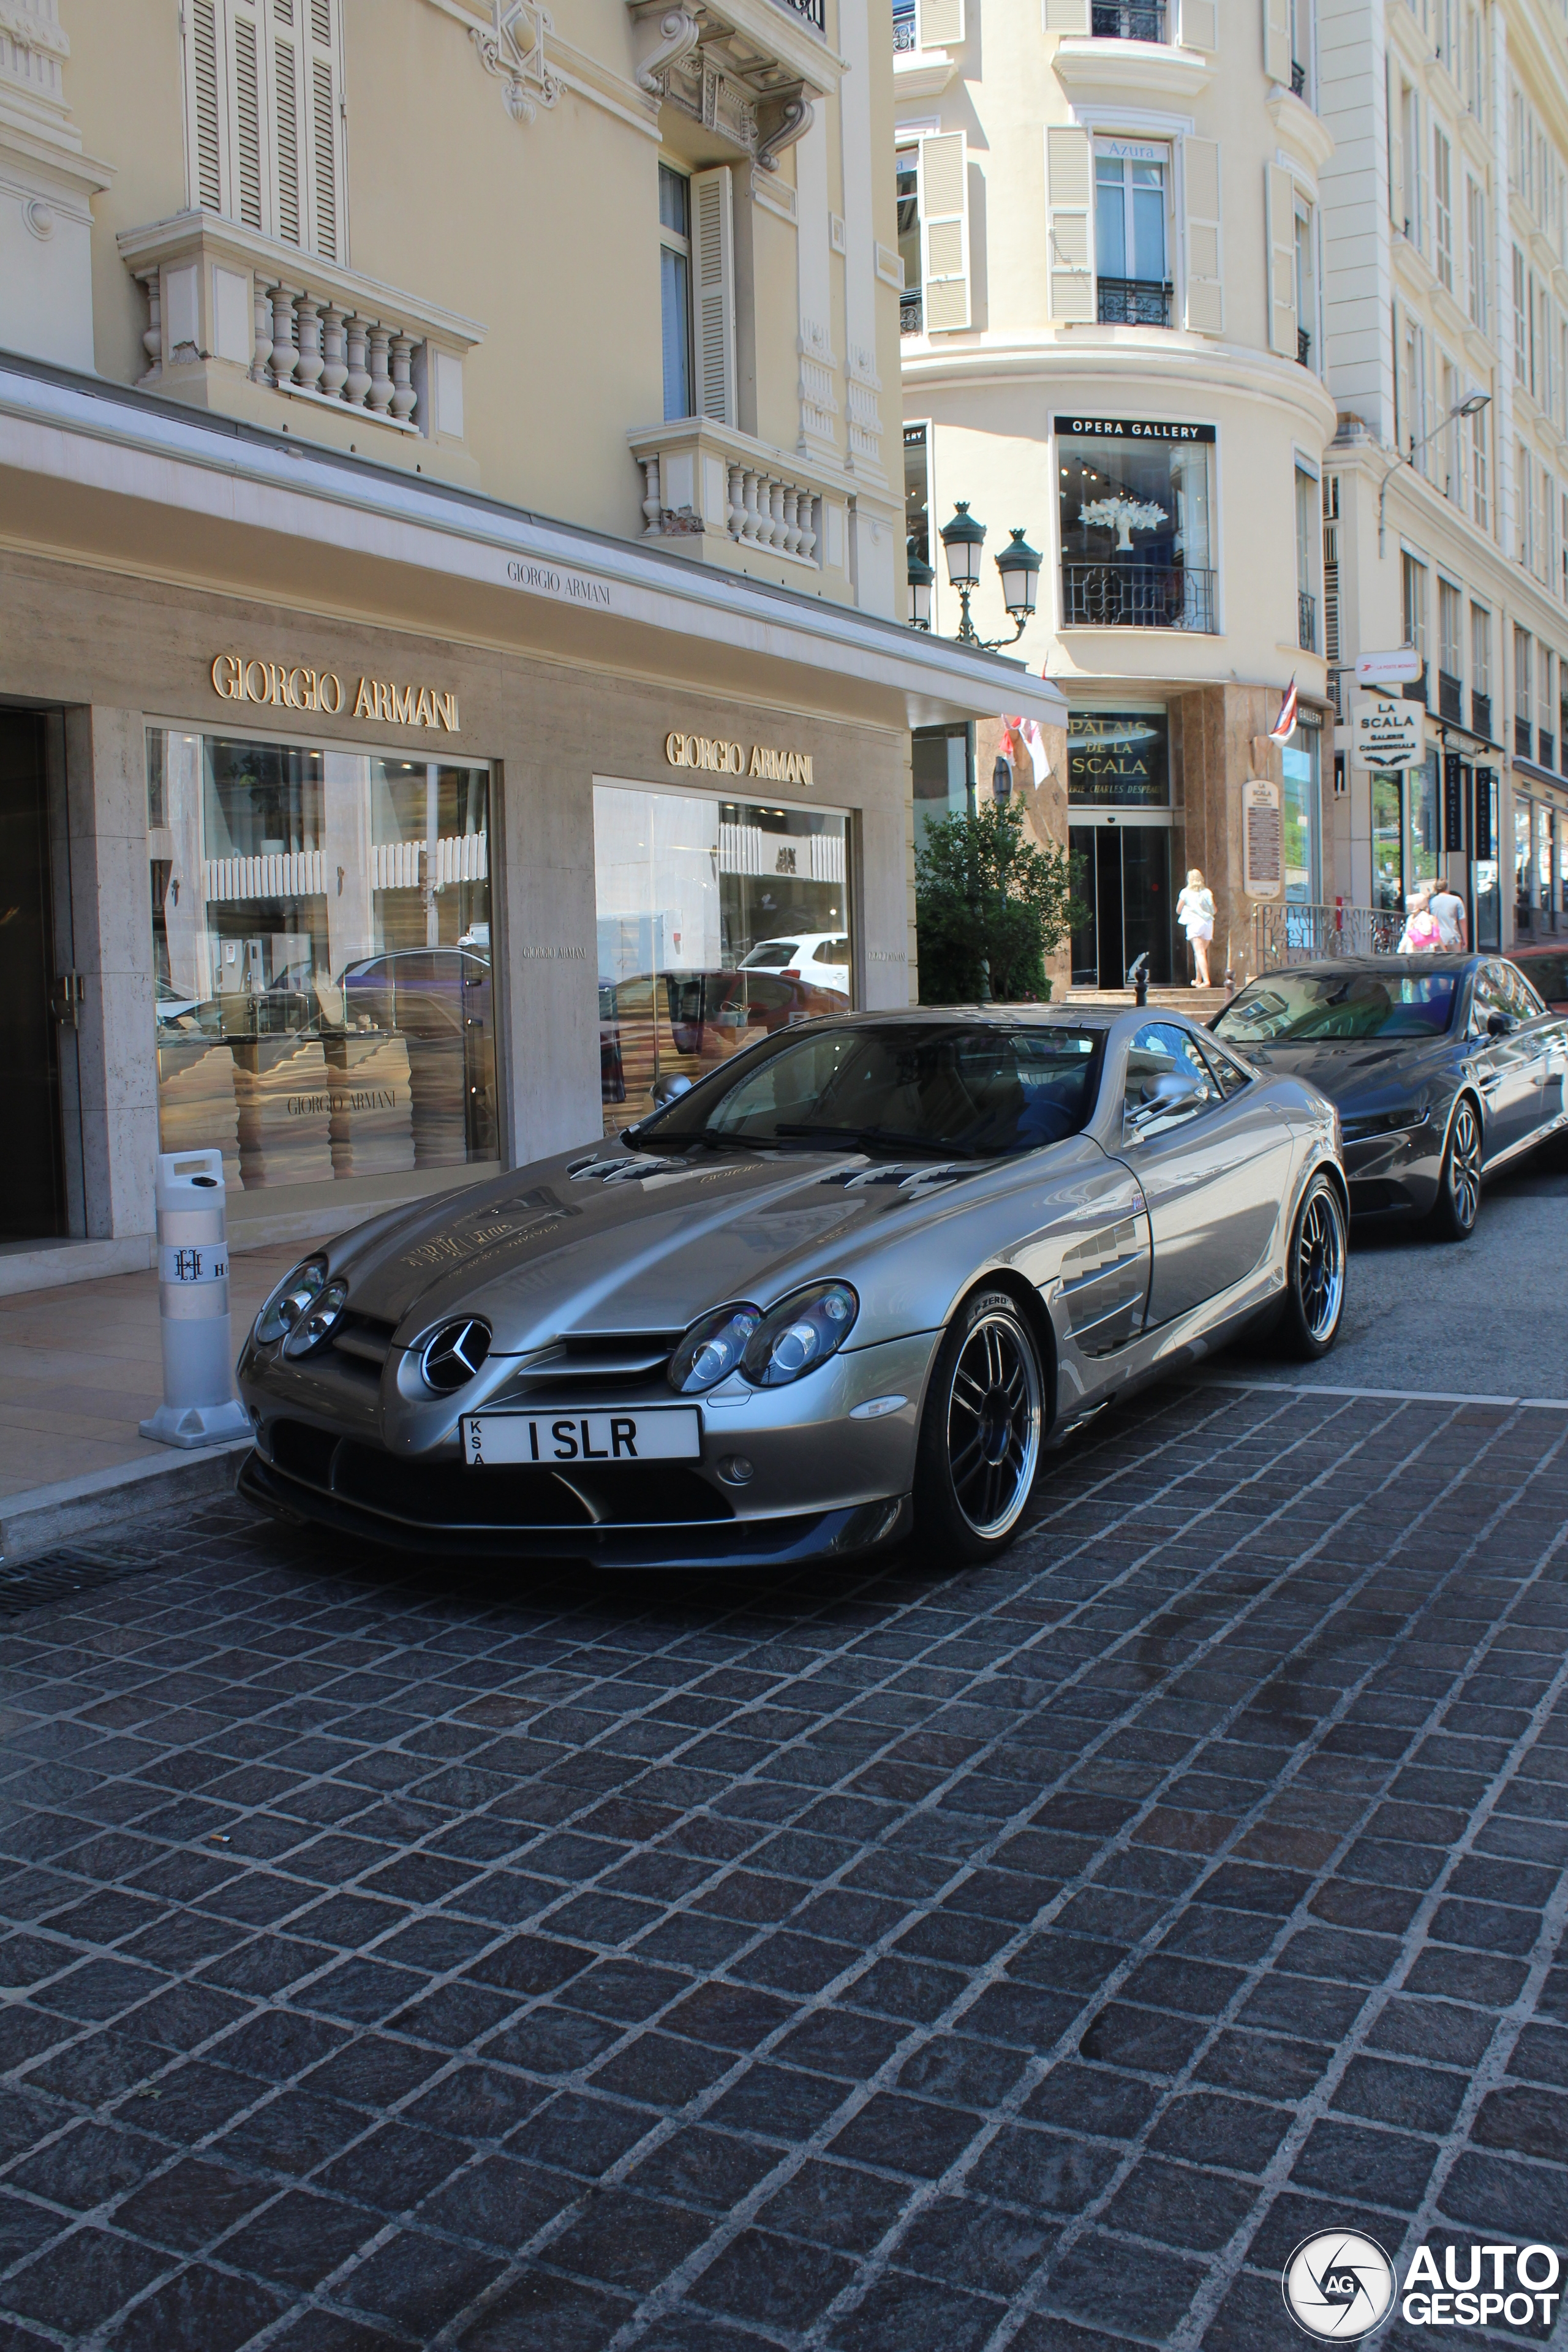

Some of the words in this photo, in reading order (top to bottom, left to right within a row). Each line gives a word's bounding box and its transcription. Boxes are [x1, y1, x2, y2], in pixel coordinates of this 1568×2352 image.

[1109, 141, 1154, 158] Azura
[903, 431, 922, 441] ERY
[1072, 420, 1123, 434] OPERA
[1131, 424, 1198, 439] GALLERY
[507, 561, 560, 592] GIORGIO
[565, 577, 611, 605] ARMANI
[211, 654, 346, 714] GIORGIO
[353, 676, 461, 732] ARMANI
[1378, 703, 1395, 713] LA
[1069, 719, 1147, 736] PALAIS
[1360, 715, 1414, 728] SCALA
[1085, 742, 1106, 753] DE
[1112, 742, 1133, 753] LA
[666, 731, 745, 775] GIORGIO
[748, 744, 814, 786] ARMANI
[1072, 758, 1148, 774] SCALA
[1090, 785, 1124, 793] CHARLES
[523, 946, 556, 959] GIORGIO
[558, 947, 586, 959] ARMANI
[287, 1094, 343, 1115] GIORGIO
[349, 1090, 396, 1110] ARMANI
